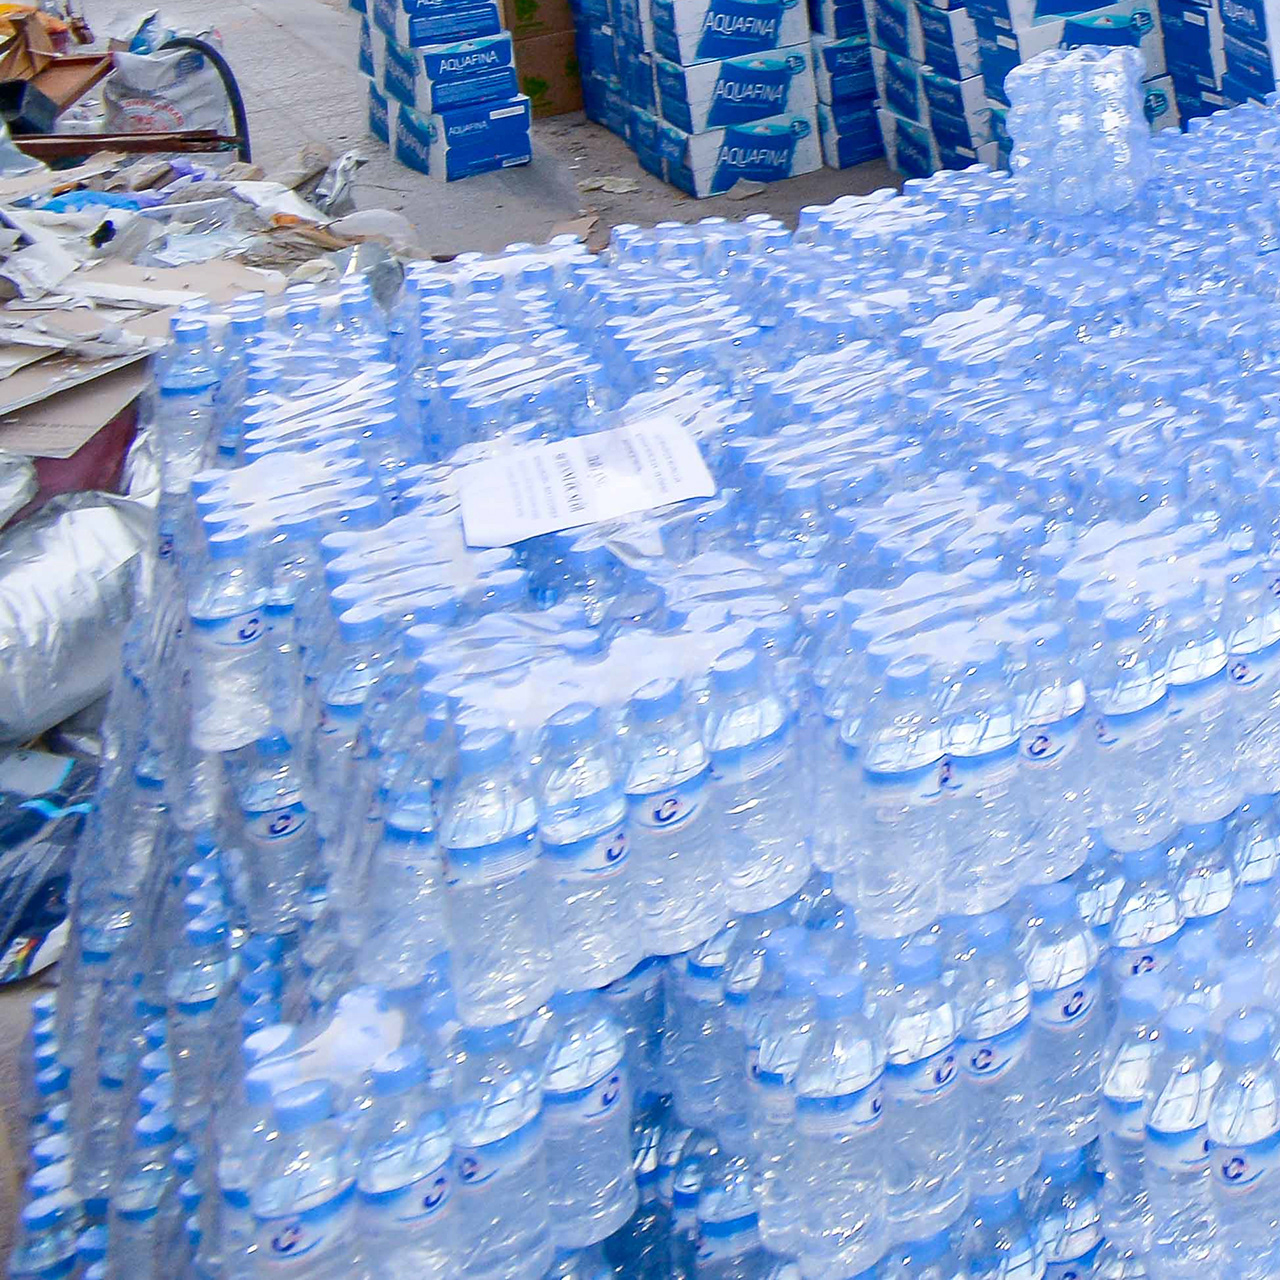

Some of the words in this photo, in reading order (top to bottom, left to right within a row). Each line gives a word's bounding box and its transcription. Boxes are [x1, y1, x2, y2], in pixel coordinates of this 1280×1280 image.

[705, 9, 777, 39] AQUAFINA
[439, 49, 498, 74] AQUAFINA
[716, 74, 785, 103] AQUAFINA
[447, 119, 489, 137] AQUAFINA
[720, 142, 789, 172] AQUAFINA
